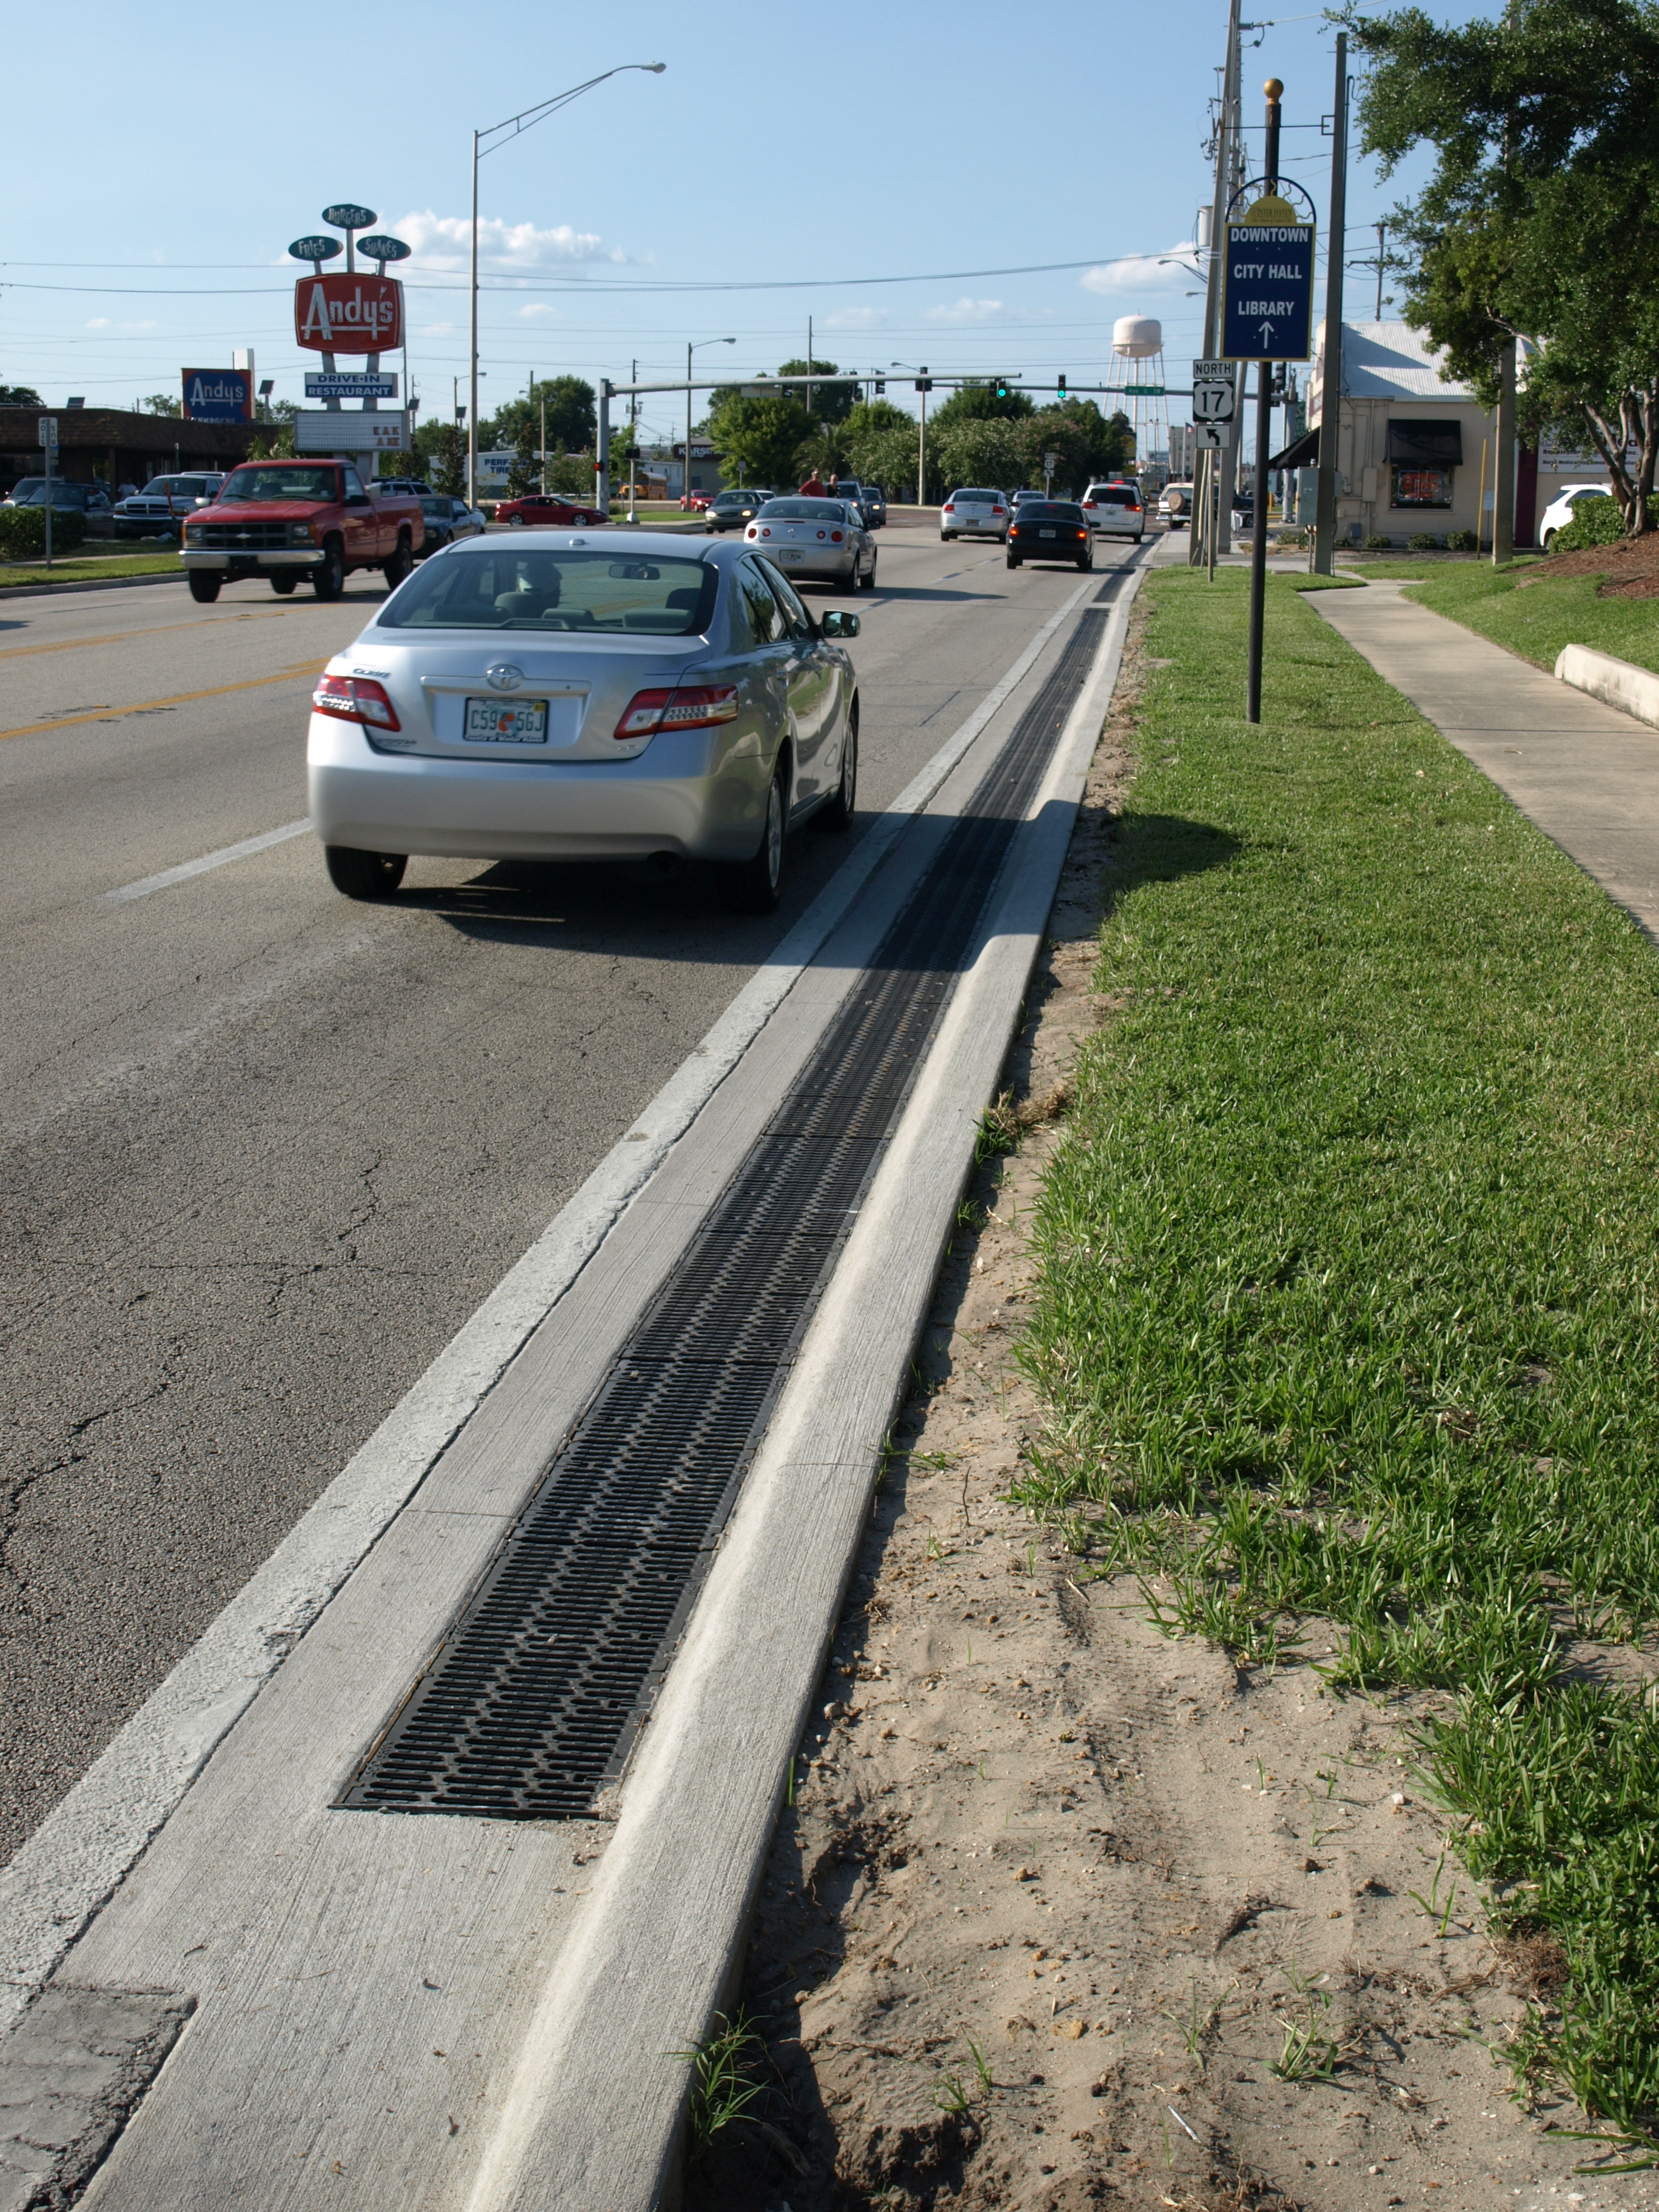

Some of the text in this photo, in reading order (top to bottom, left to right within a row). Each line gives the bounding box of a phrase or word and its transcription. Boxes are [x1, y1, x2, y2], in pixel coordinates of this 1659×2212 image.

[327, 207, 366, 225] BURGERS
[1231, 227, 1309, 243] DOWNTOWN
[298, 238, 326, 258] FRIES
[365, 238, 398, 258] SHAKES
[1233, 264, 1302, 279] CITY HALL
[301, 283, 394, 341] Andy's
[1238, 301, 1295, 315] LIBRARY
[1196, 363, 1231, 375] NORTH
[308, 387, 390, 395] RESTAURANT
[1202, 390, 1225, 413] 17
